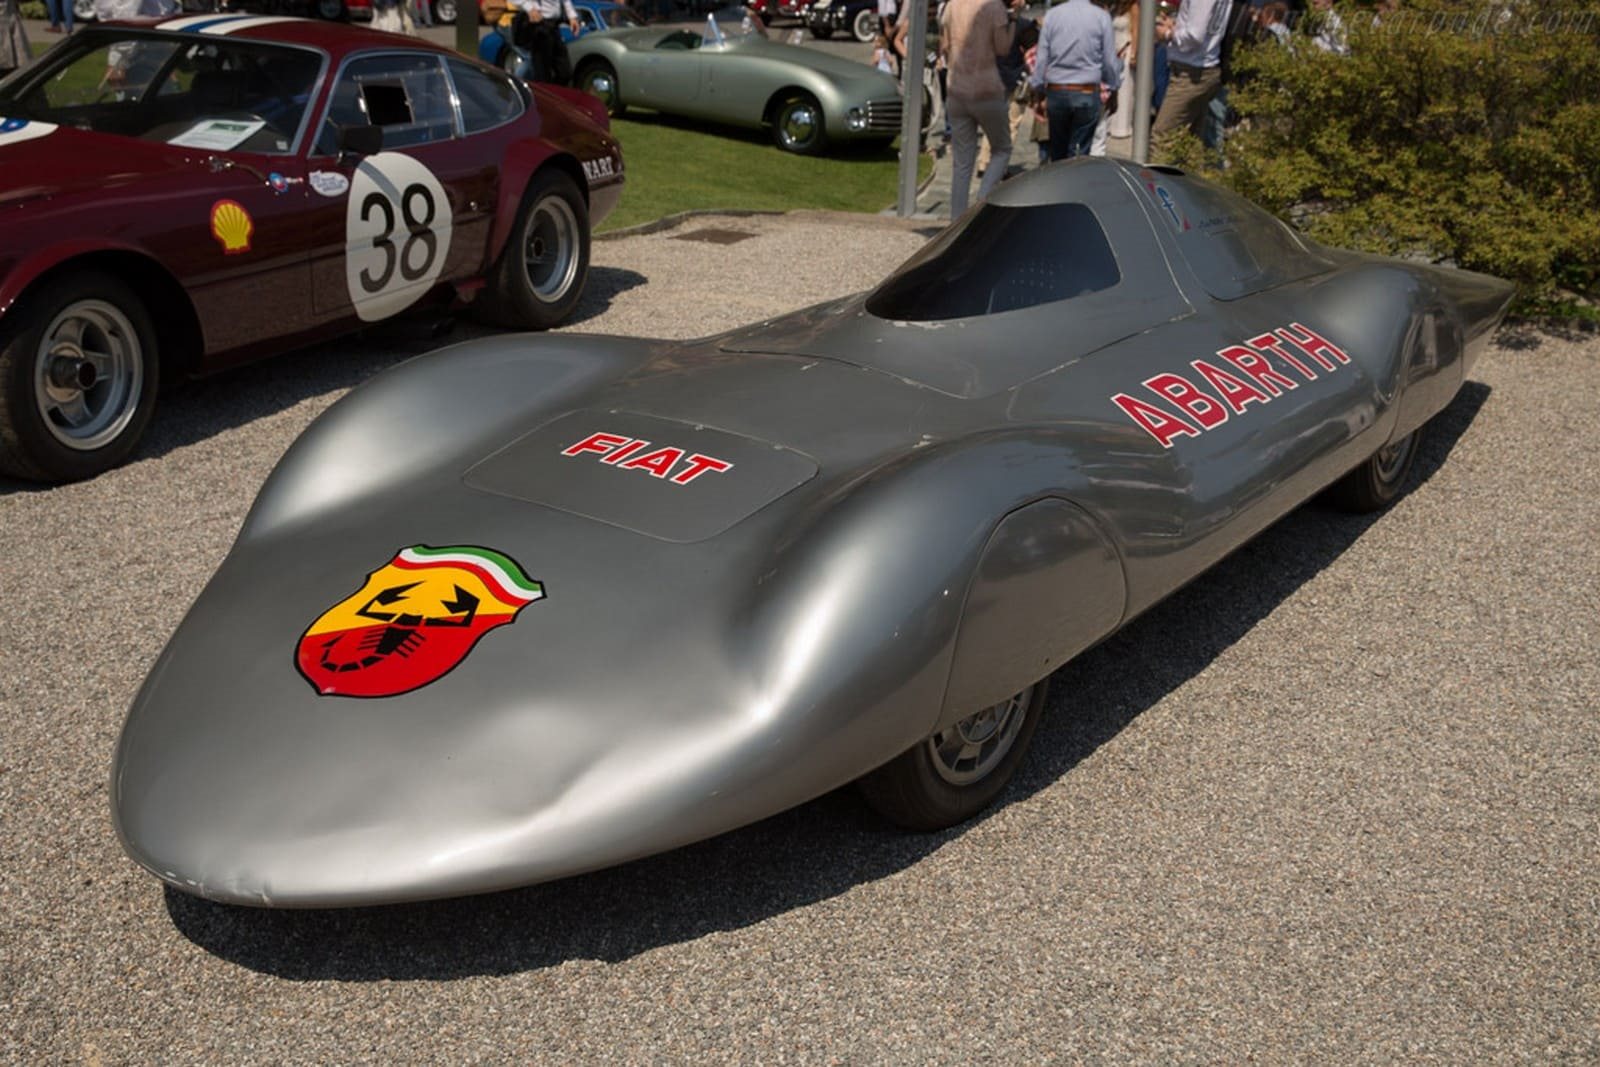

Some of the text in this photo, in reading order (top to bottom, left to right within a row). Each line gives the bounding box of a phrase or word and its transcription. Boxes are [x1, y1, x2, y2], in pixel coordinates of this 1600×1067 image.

[360, 183, 438, 293] 38
[1110, 322, 1352, 448] ABARTH
[560, 432, 735, 485] FIAT
